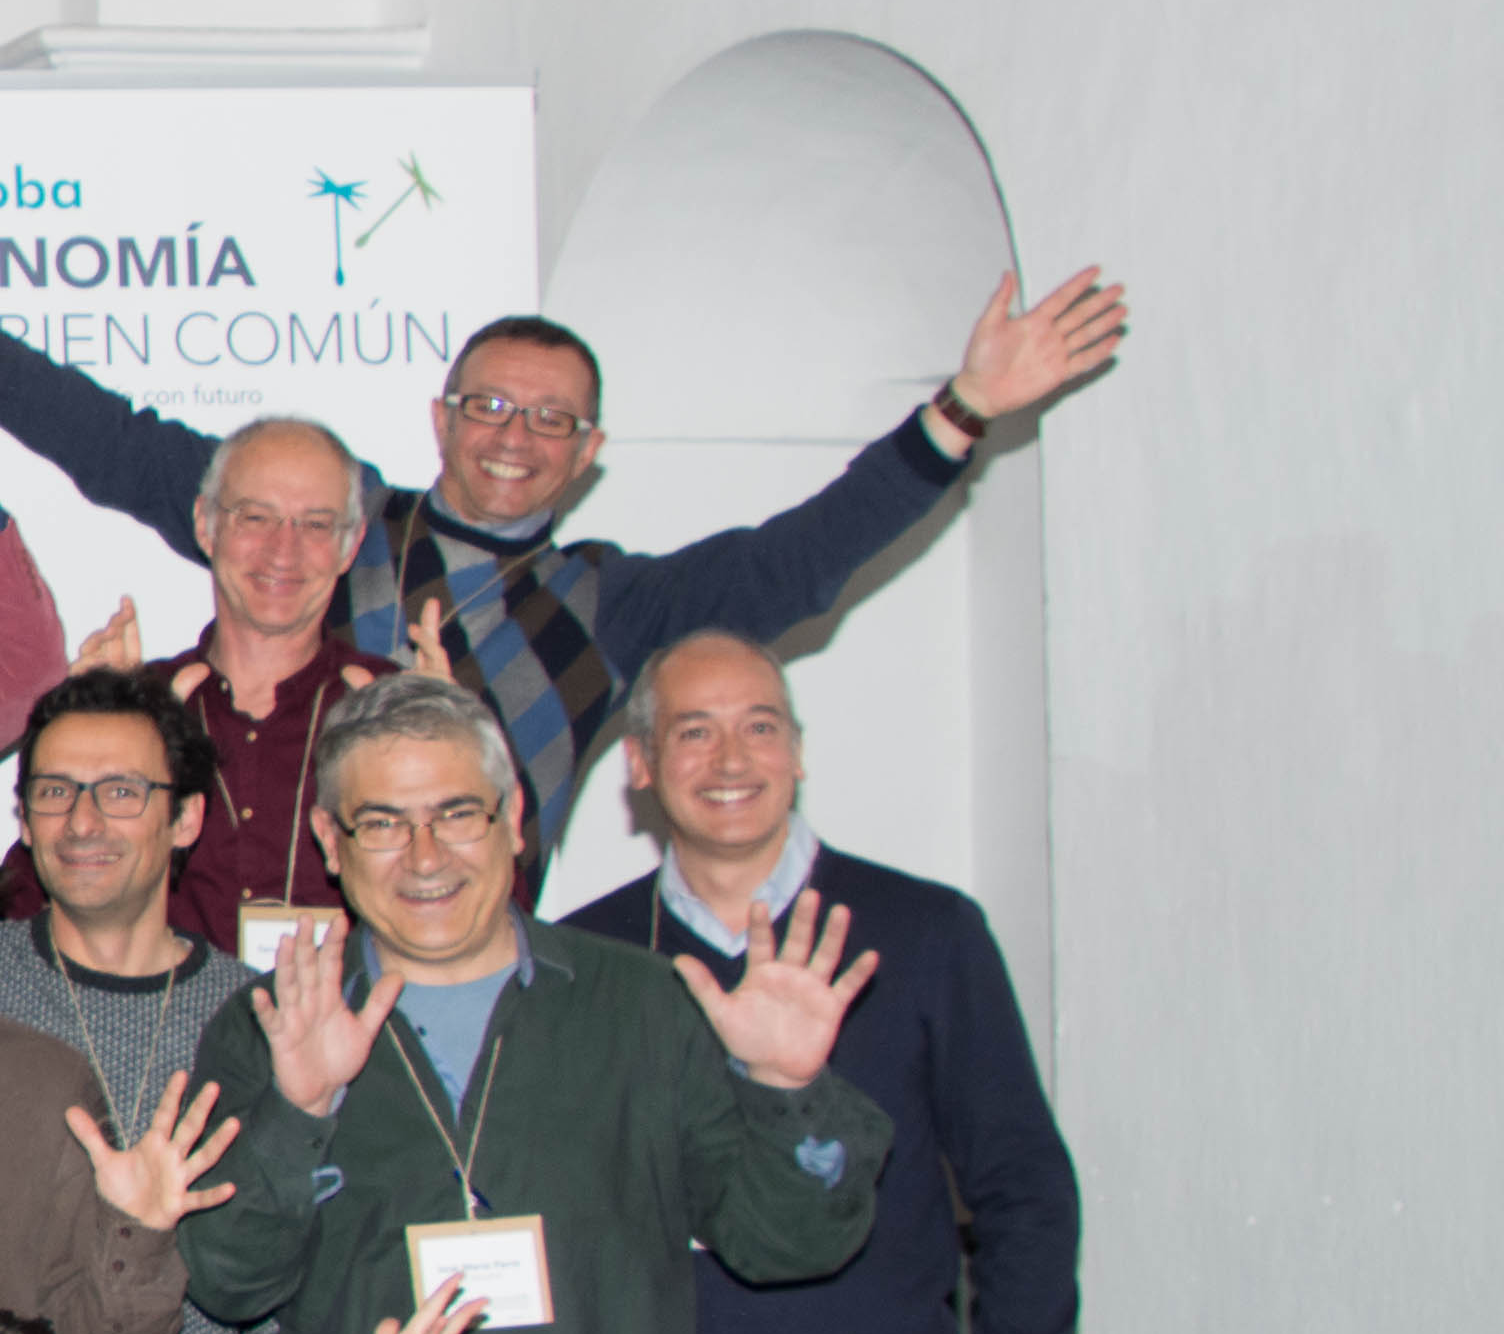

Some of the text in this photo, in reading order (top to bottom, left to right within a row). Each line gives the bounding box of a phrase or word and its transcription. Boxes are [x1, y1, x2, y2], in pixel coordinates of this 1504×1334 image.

[175, 297, 449, 366] COMÚN
[143, 389, 185, 405] con
[194, 383, 264, 405] futuro
